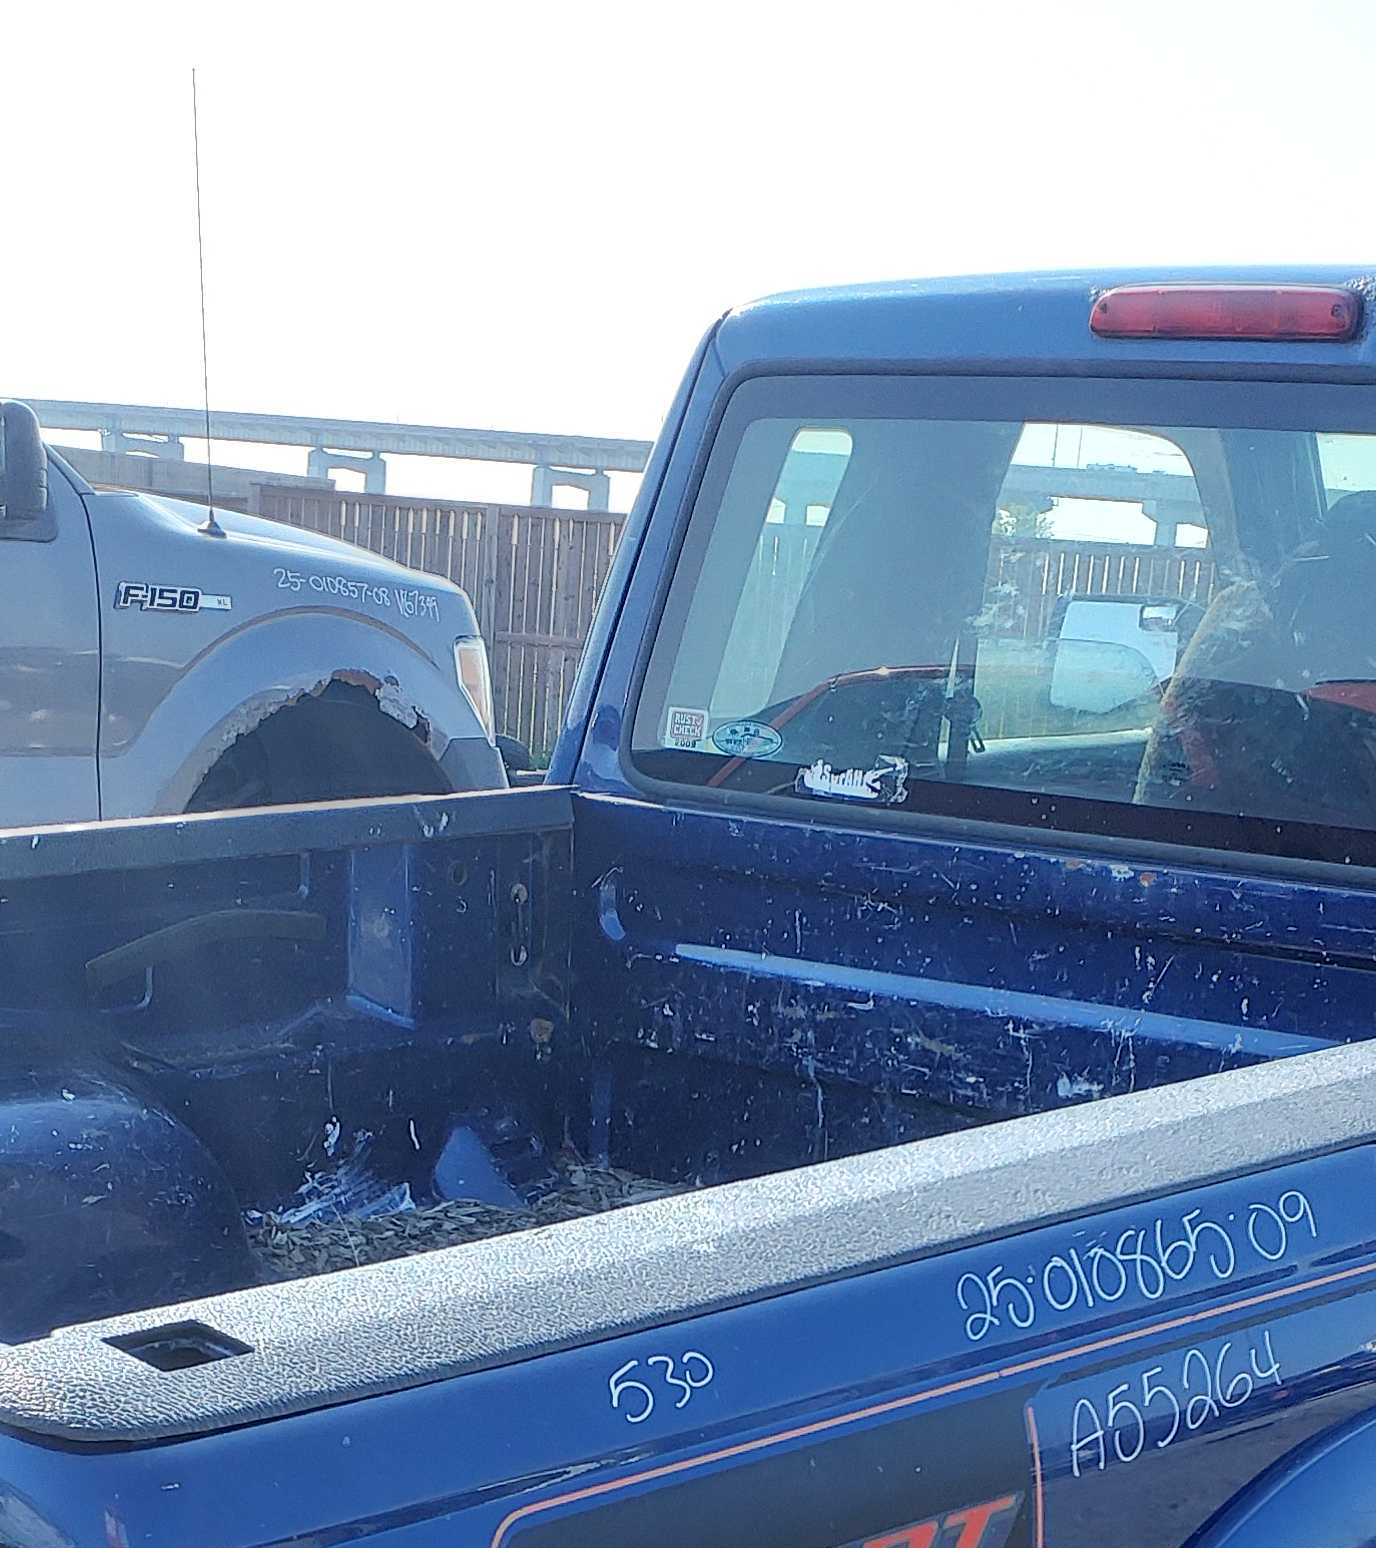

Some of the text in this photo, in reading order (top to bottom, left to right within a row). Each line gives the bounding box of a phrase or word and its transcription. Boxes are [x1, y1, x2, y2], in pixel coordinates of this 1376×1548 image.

[118, 582, 201, 612] F-150
[273, 567, 391, 607] 25-010857-08
[674, 724, 701, 737] CHECK
[675, 712, 697, 725] RUST
[609, 1351, 714, 1423] 530
[1070, 1330, 1283, 1477] A55264
